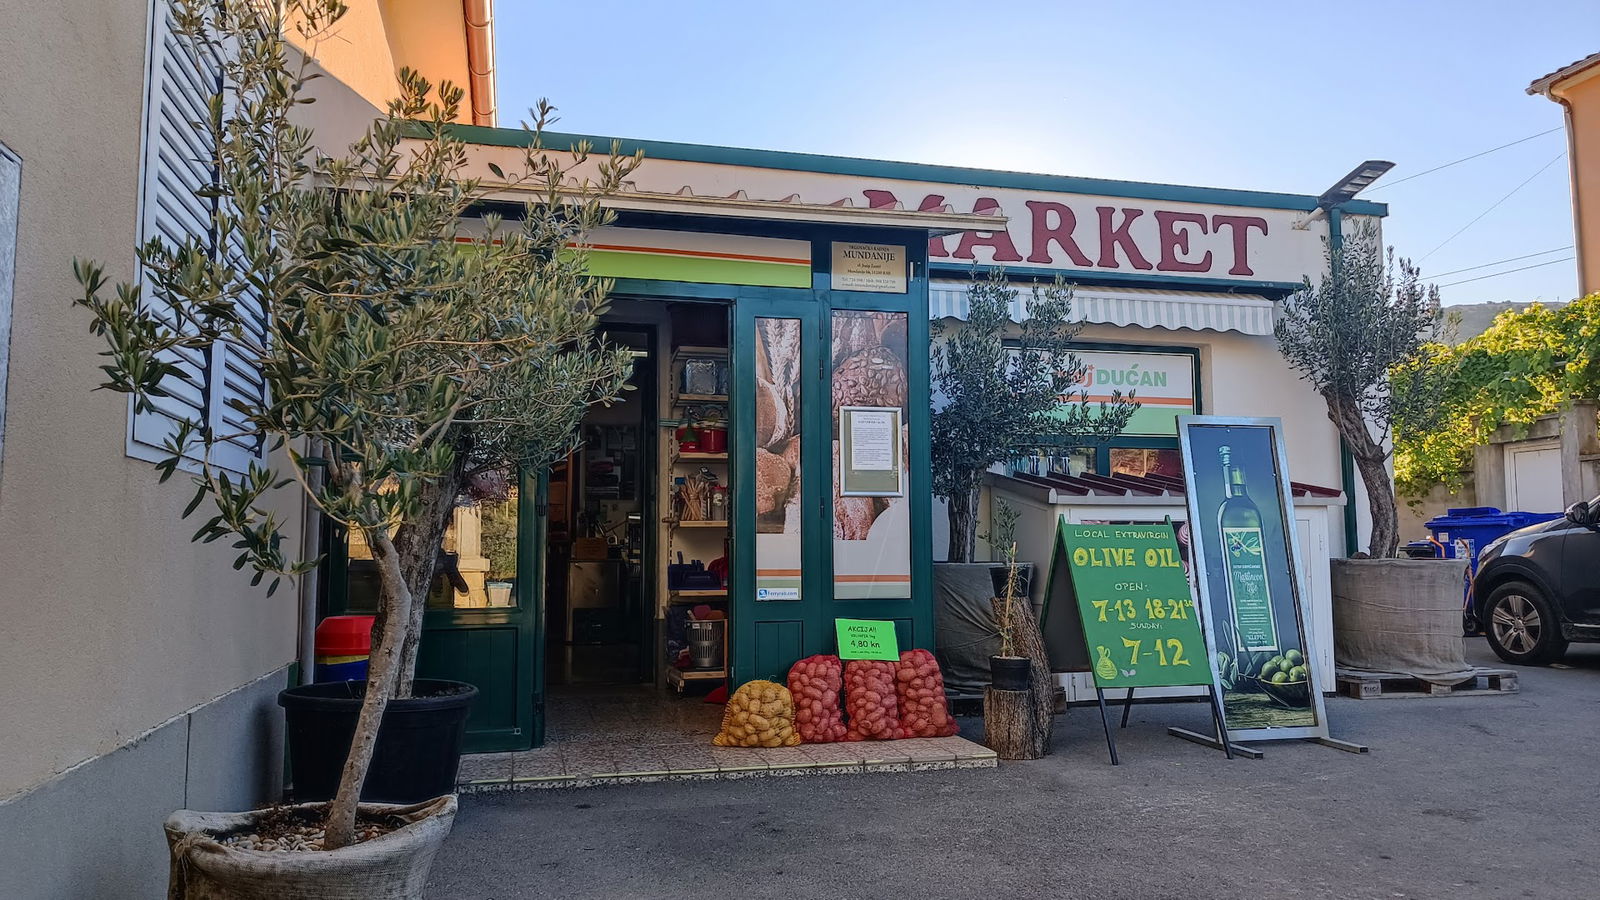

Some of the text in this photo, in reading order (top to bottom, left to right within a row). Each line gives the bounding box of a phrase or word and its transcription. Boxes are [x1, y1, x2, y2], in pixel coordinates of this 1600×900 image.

[843, 250, 895, 262] MUNDANIJE
[1096, 363, 1167, 388] DUĆAN
[1074, 530, 1169, 540] LOCAL EXTRAVIRGIN
[1073, 547, 1180, 568] OLIVE OIL
[1115, 582, 1150, 592] OPEN:
[1091, 599, 1137, 623] 7-13
[850, 640, 880, 649] 4,80 kn
[1121, 636, 1191, 666] 7-12
